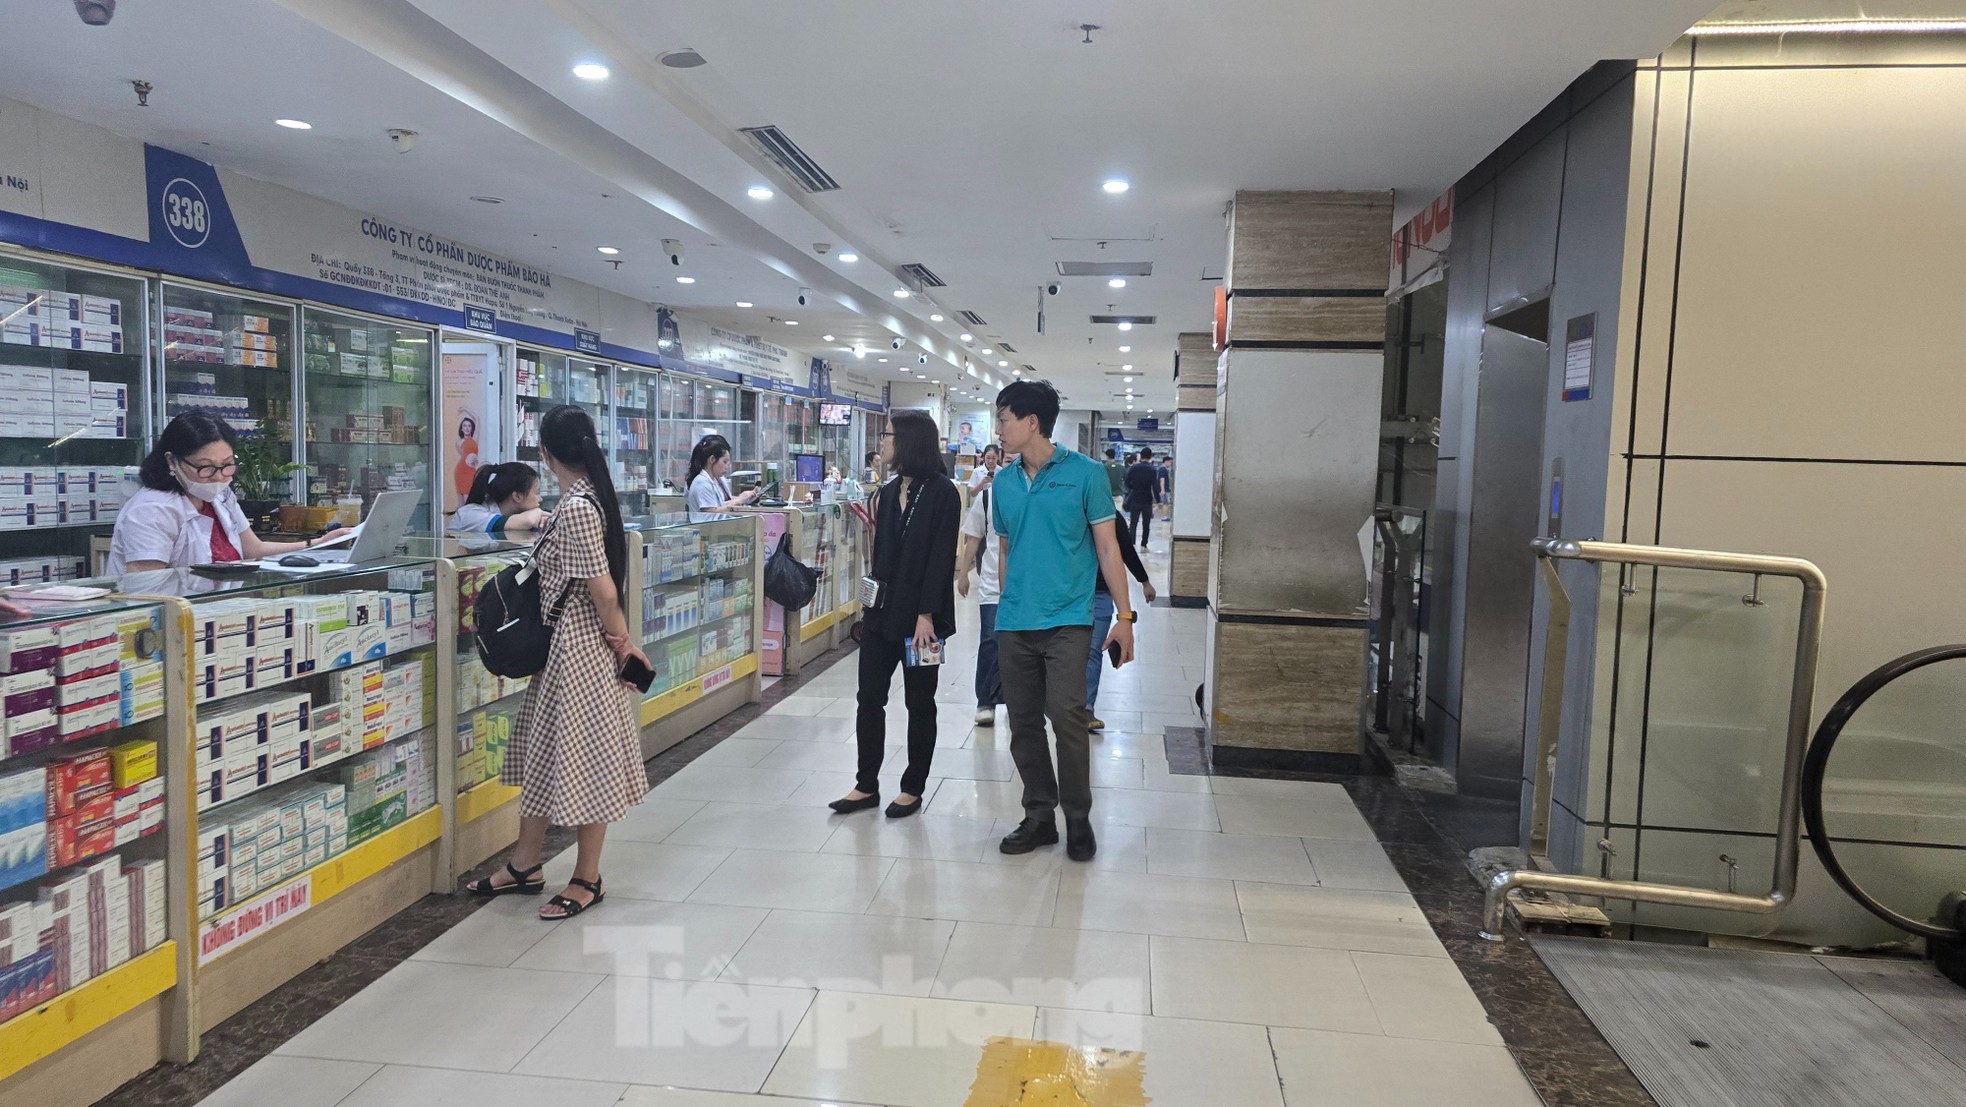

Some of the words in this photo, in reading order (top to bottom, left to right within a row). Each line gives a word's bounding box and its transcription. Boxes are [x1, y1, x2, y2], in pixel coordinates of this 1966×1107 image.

[6, 175, 29, 192] Nội
[168, 193, 206, 233] 338
[361, 217, 397, 243] CÔNG
[399, 230, 413, 248] TY
[417, 234, 434, 254] CỔ
[436, 242, 464, 263] PHẦN
[467, 251, 493, 273] DƯỢC
[495, 259, 521, 280] PHẨM
[310, 253, 325, 267] ĐỊA
[344, 261, 362, 275] Quầy
[401, 275, 408, 285] TT
